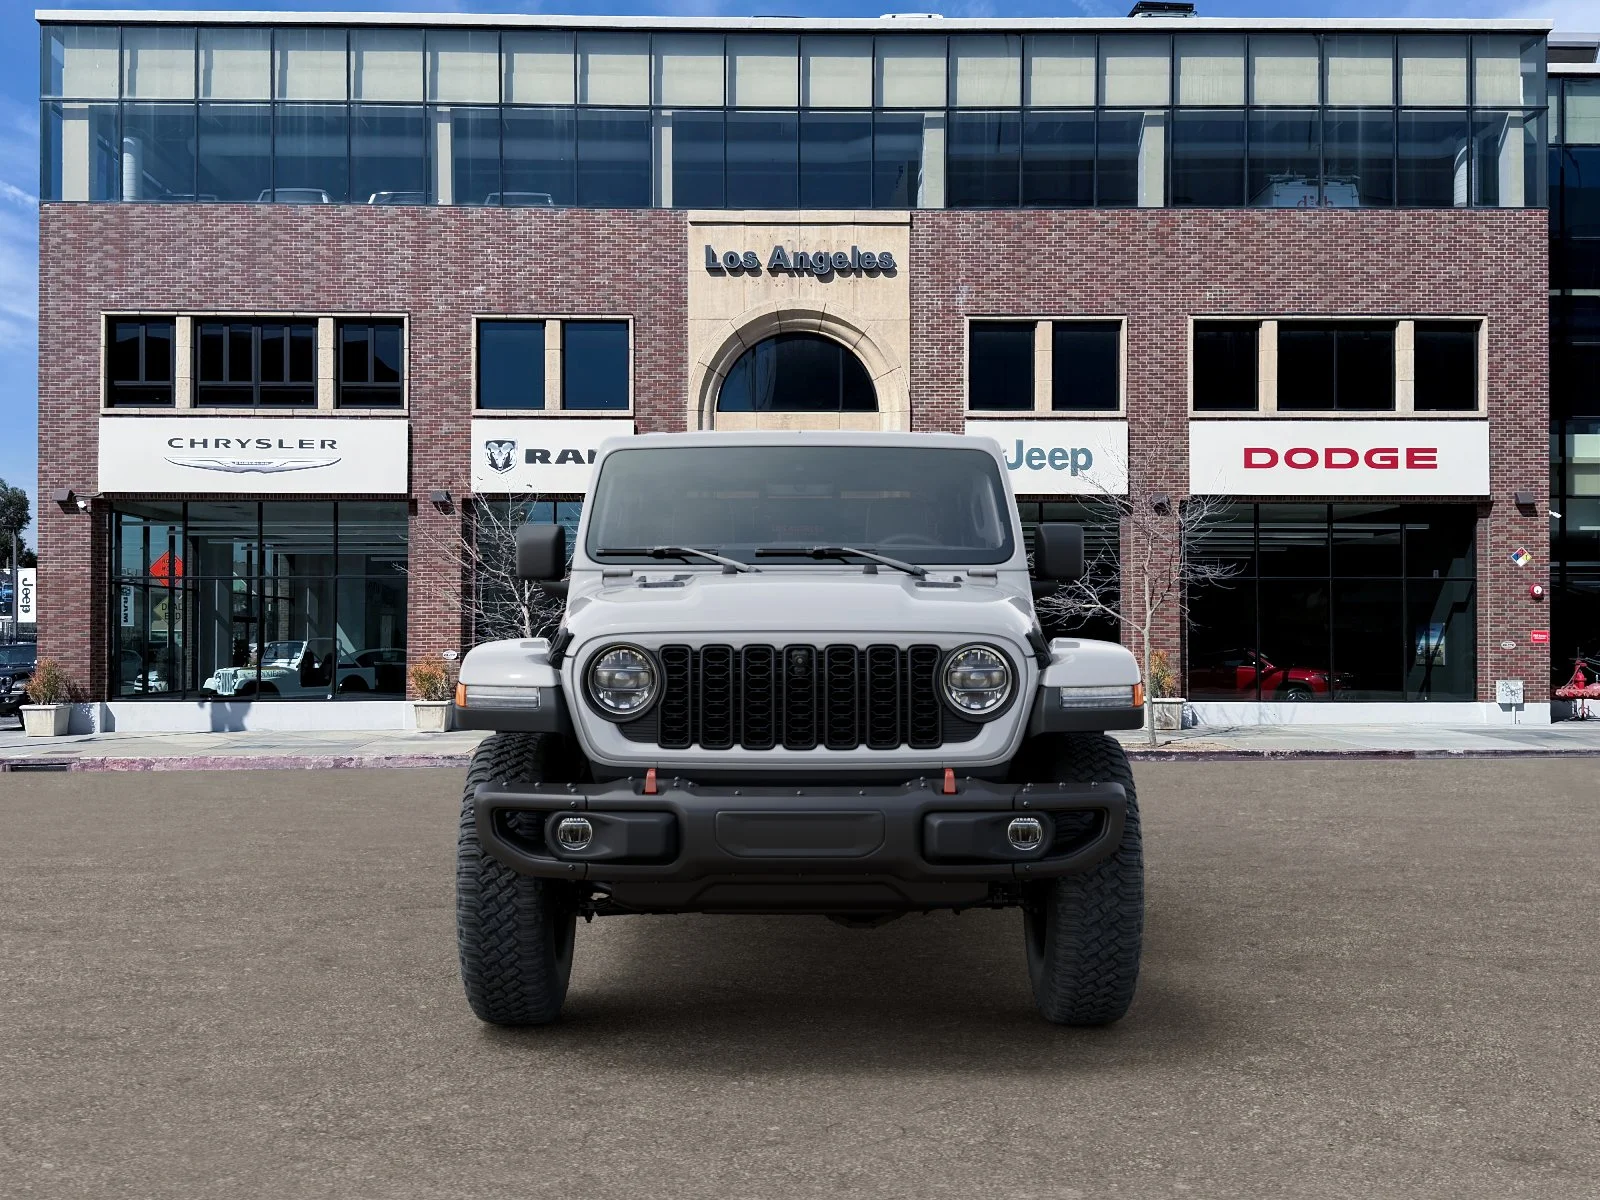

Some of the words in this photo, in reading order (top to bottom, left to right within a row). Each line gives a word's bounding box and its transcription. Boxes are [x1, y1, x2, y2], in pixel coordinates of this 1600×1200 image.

[1297, 195, 1334, 207] dih
[705, 245, 758, 269] Los
[767, 245, 894, 275] Angeles
[167, 438, 338, 449] CHRYSLER
[1005, 439, 1093, 476] Jeep
[1244, 448, 1438, 469] DODGE
[20, 577, 33, 613] Jeep
[164, 612, 181, 620] ED
